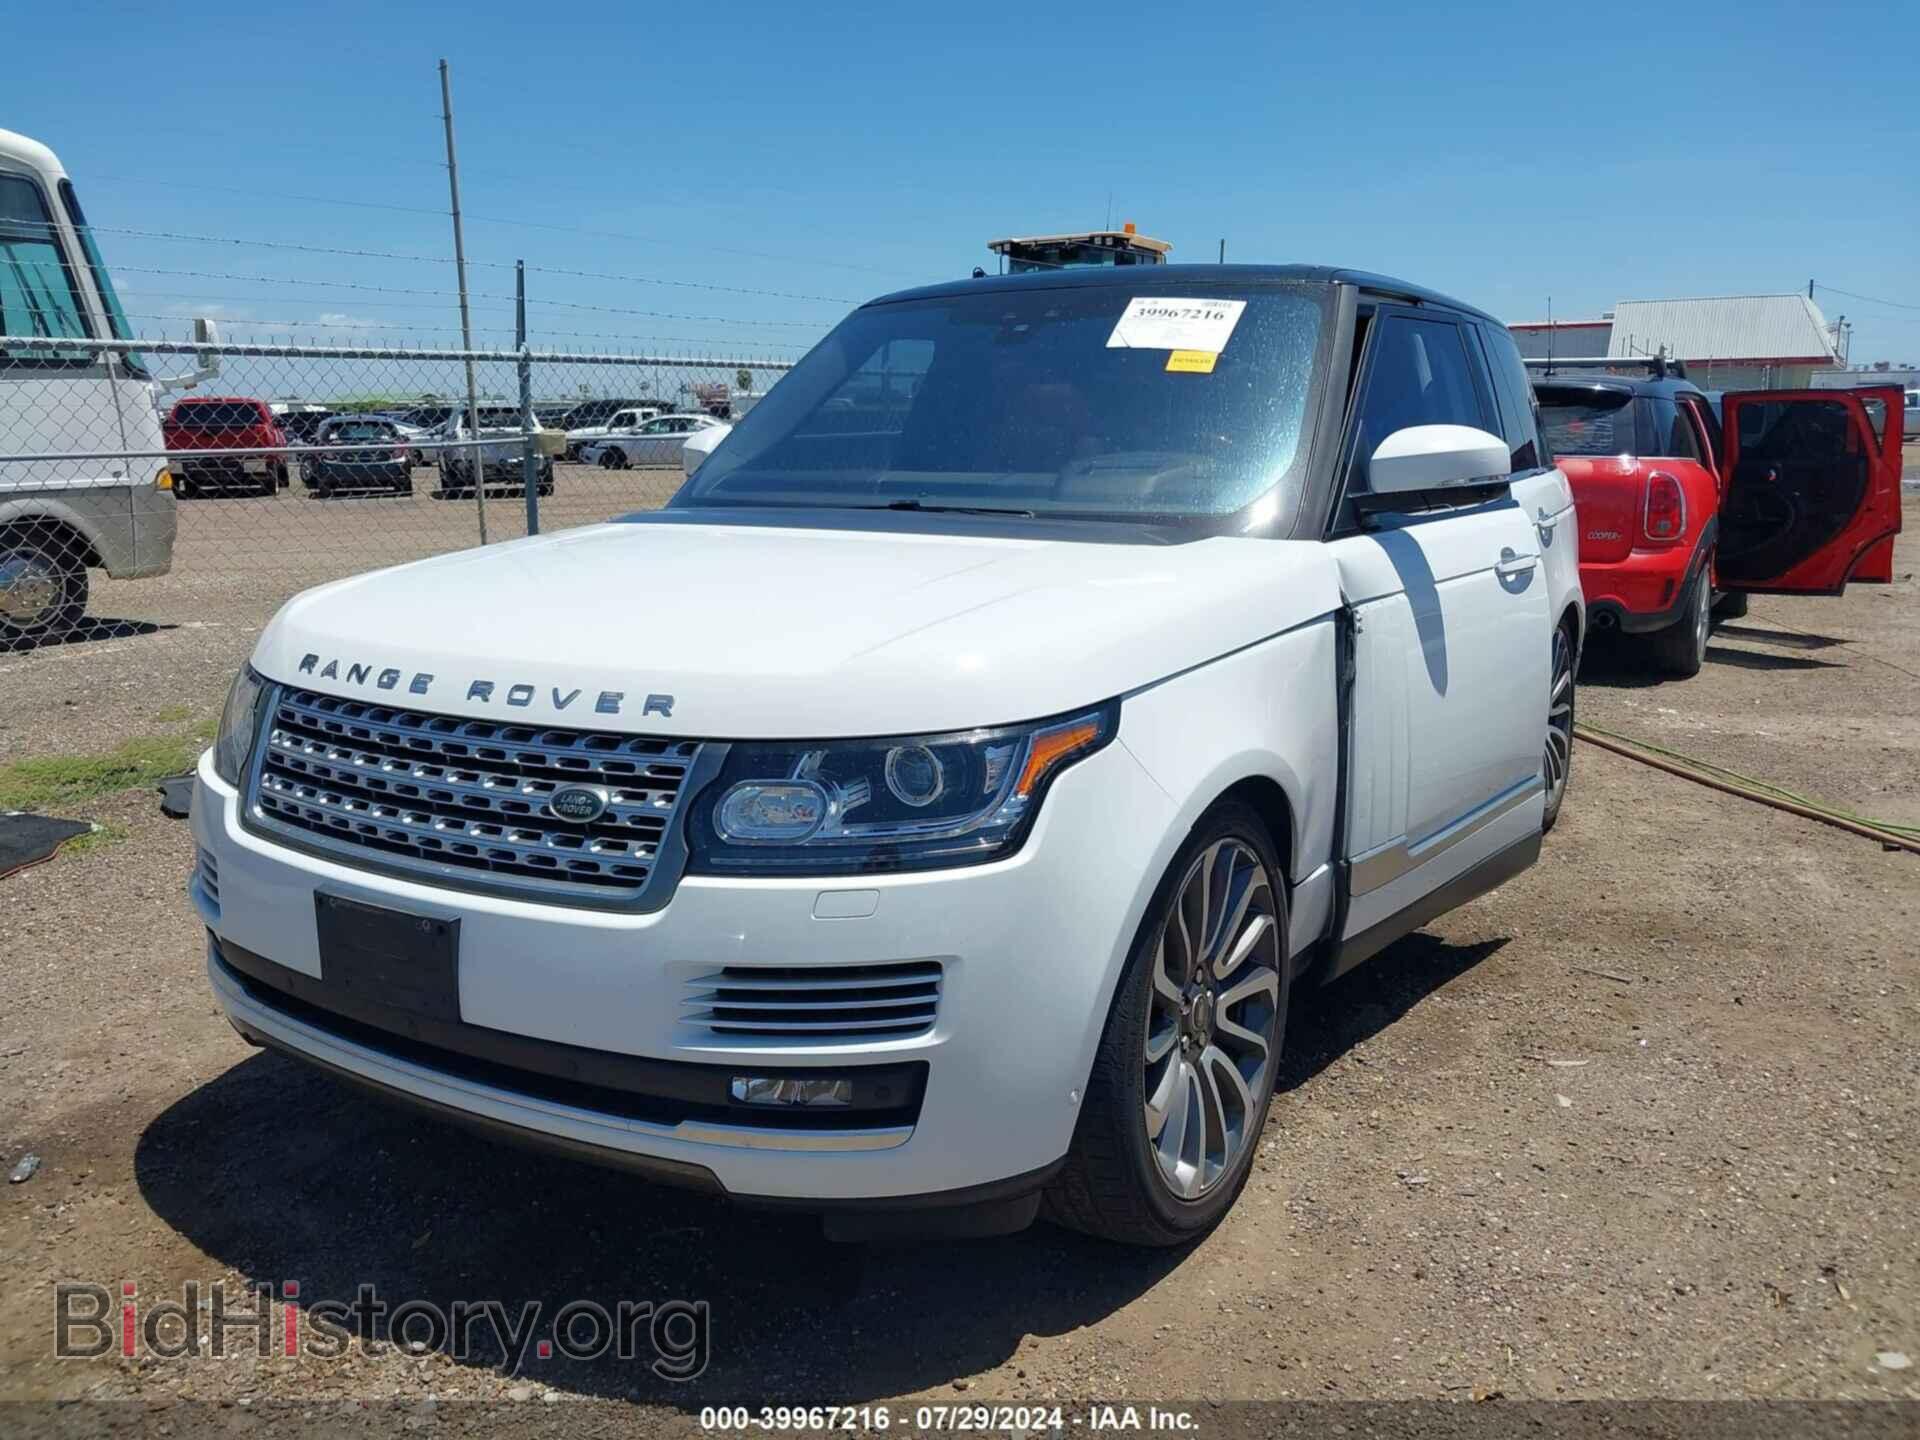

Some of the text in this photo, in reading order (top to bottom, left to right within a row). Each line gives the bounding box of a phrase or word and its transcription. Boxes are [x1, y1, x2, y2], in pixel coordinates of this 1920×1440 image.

[1139, 308, 1224, 320] 39967216
[298, 653, 676, 718] RANGE ROVER
